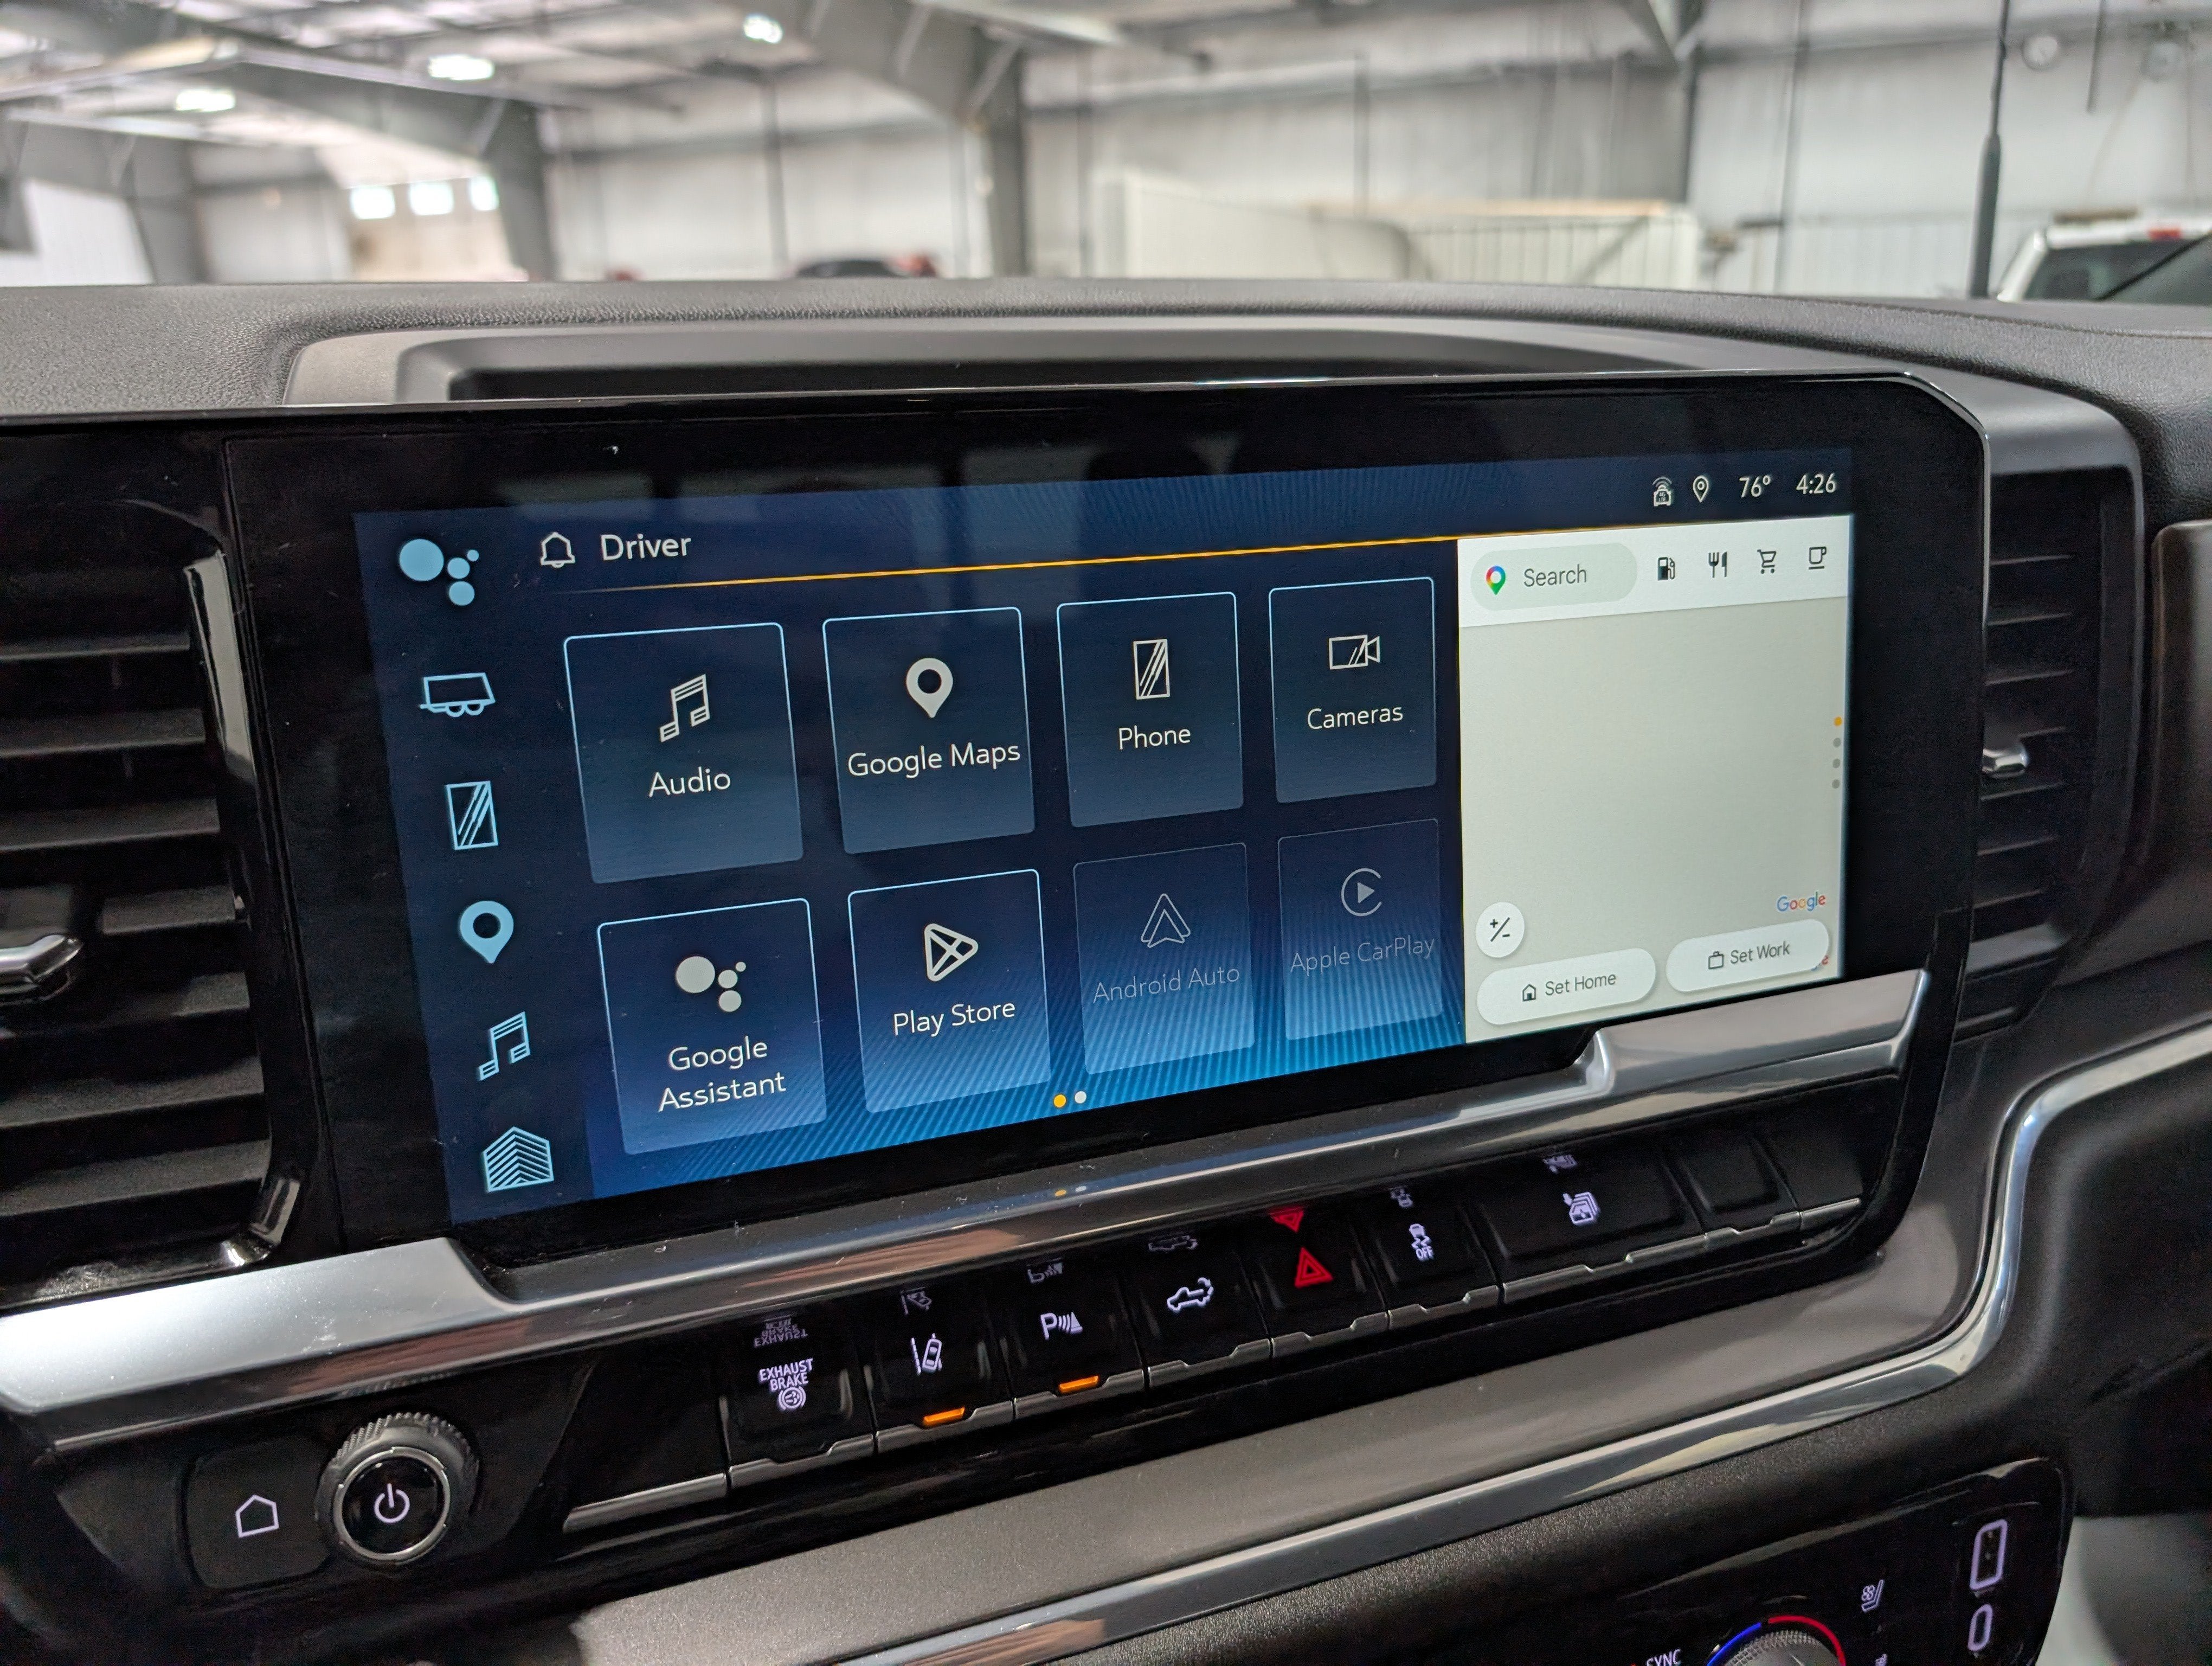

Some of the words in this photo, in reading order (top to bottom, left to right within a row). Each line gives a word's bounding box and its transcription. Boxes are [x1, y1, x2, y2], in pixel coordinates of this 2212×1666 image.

[1739, 475, 1771, 498] 76°
[1796, 473, 1837, 495] 4:26
[600, 534, 691, 561] Driver
[1523, 565, 1588, 588] Search
[1307, 706, 1404, 730] Cameras
[1118, 725, 1191, 750] Phone
[847, 745, 942, 778] Google
[950, 742, 1020, 770] Maps
[647, 767, 731, 797] Audio
[1776, 891, 1826, 912] Google
[1290, 945, 1351, 976] Apple
[1357, 937, 1435, 962] CarPlay
[1729, 947, 1754, 965] Set
[1757, 940, 1790, 959] Work
[1092, 969, 1181, 1003] Android
[1187, 967, 1240, 989] Auto
[1544, 978, 1571, 997] Set
[1574, 971, 1617, 991] Home
[892, 1009, 944, 1037] Play
[951, 1002, 1017, 1027] Store
[667, 1036, 768, 1072] Google
[658, 1072, 787, 1112] Assistant
[1416, 1245, 1433, 1260] OFF
[758, 1357, 813, 1382] EXHAUST
[770, 1372, 809, 1392] BRAKE
